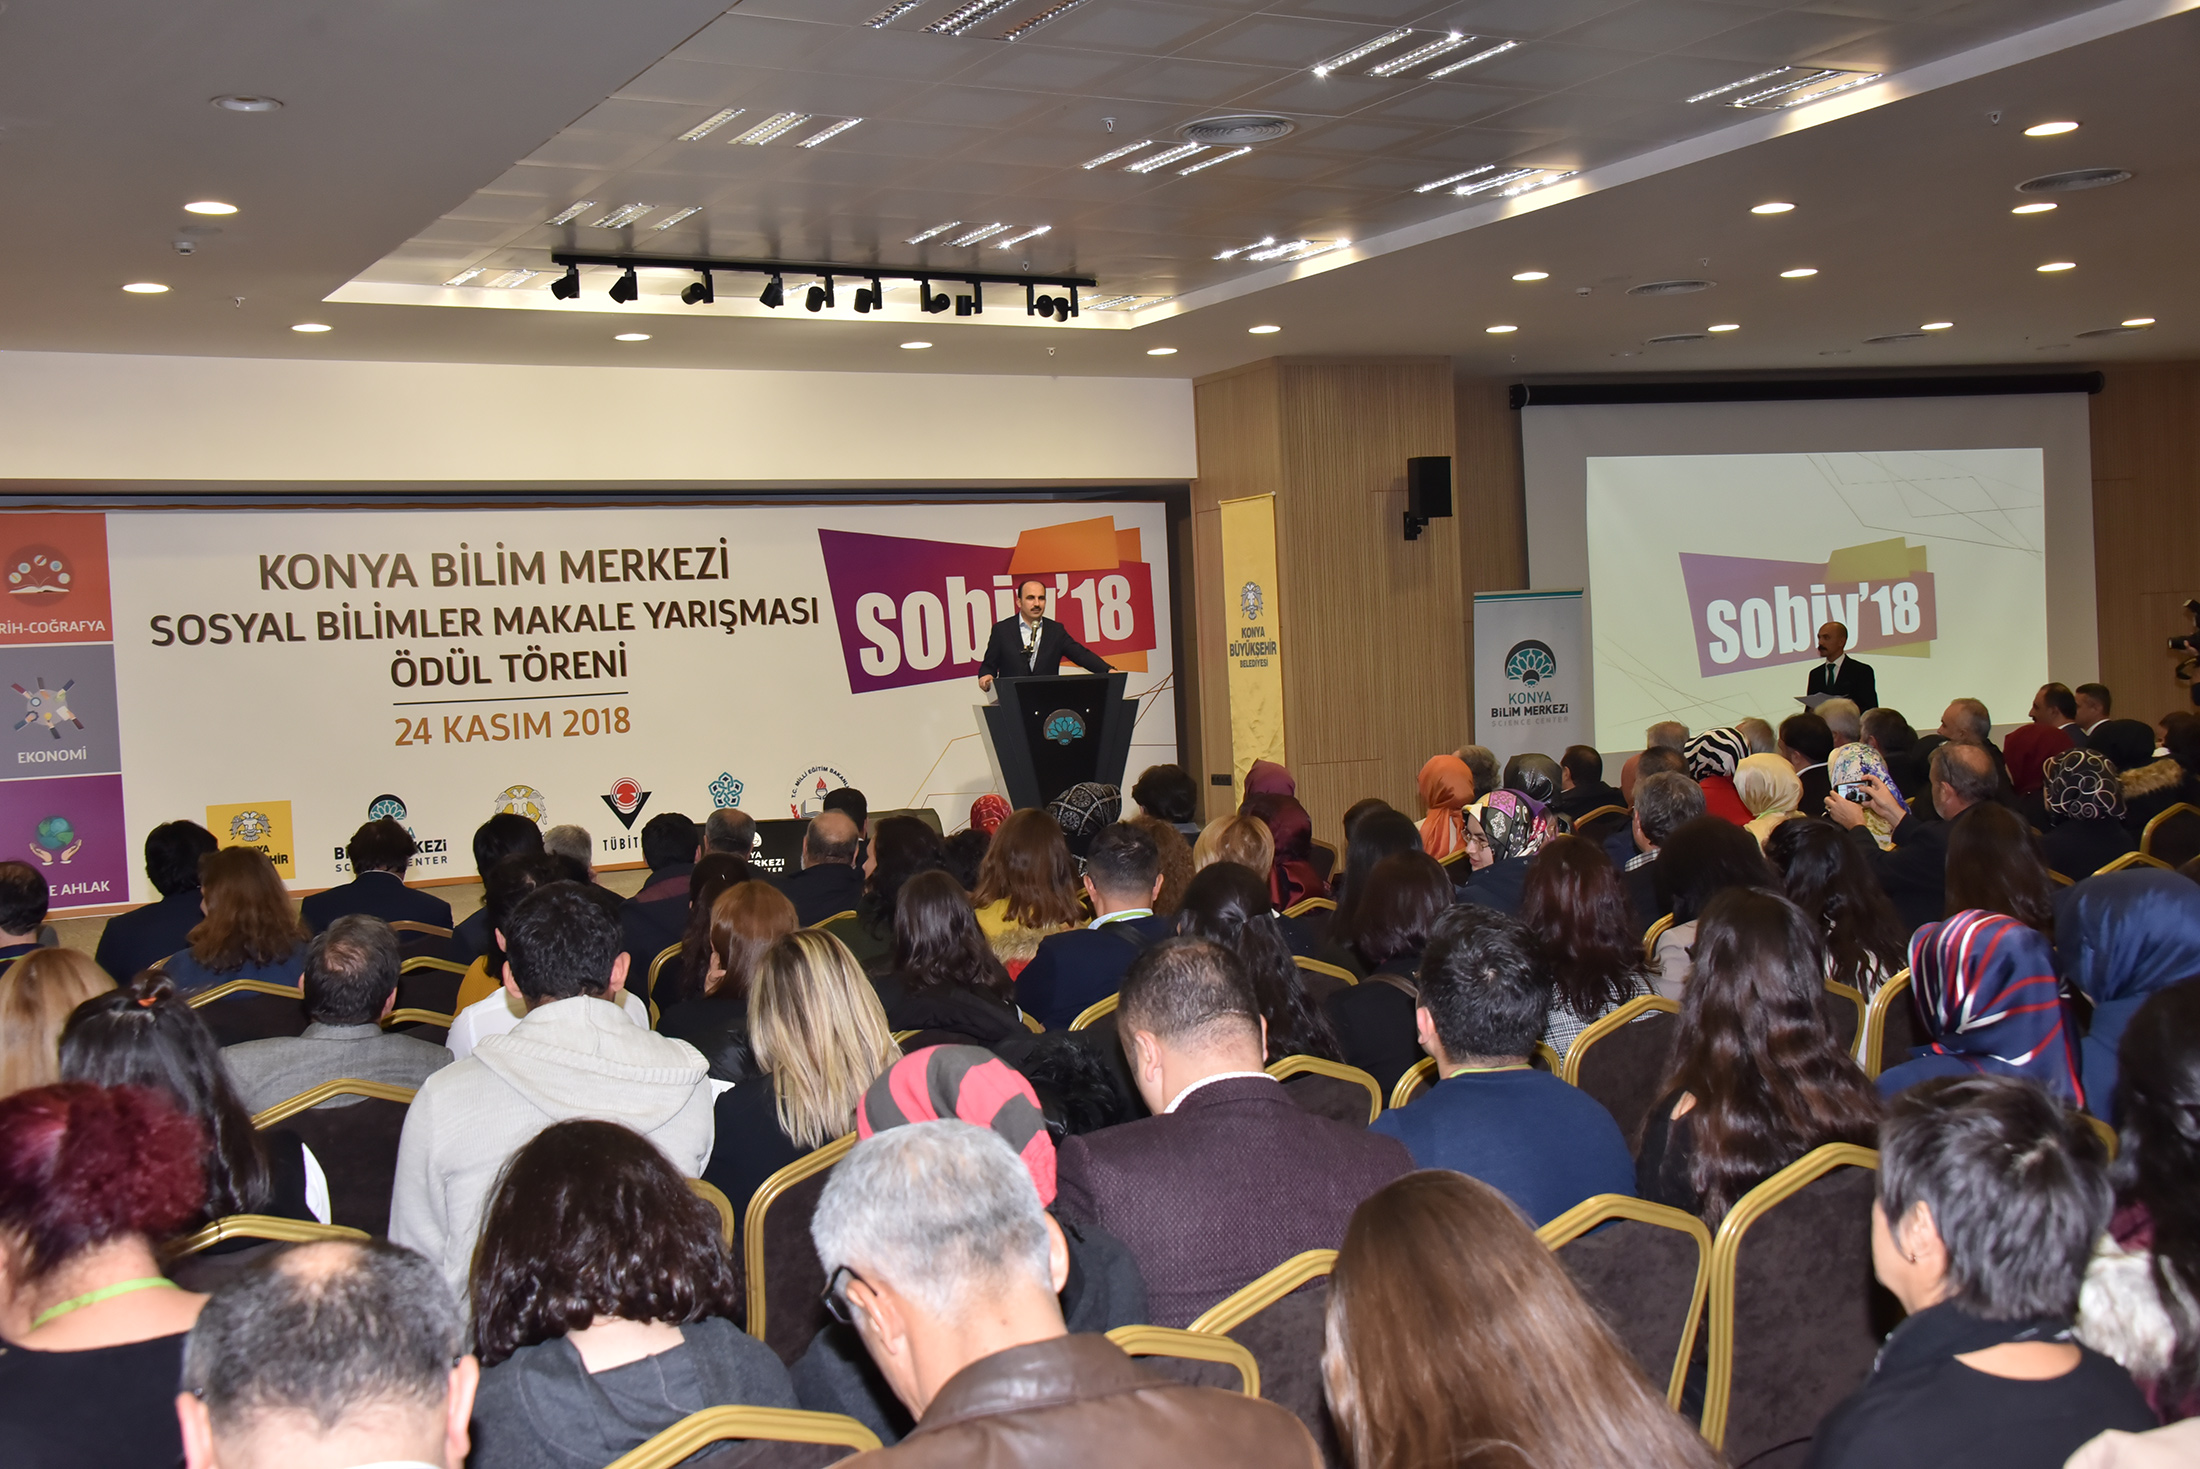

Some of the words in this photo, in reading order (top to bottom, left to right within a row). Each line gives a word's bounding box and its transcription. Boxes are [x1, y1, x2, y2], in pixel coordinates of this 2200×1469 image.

[259, 553, 419, 591] KONYA
[431, 541, 546, 588] BİLİM
[560, 536, 729, 584] MERKEZİ
[0, 618, 106, 635] RİH-COĞRAFYA
[150, 612, 306, 647] SOSYAL
[316, 601, 483, 641] BİLİMLER
[493, 602, 636, 636] MAKALE
[643, 597, 819, 635] YARIŞMASI
[1241, 626, 1265, 639] KONYA
[1229, 638, 1277, 658] BÜYÜKŞEHİR
[391, 647, 492, 688] ÖDÜL
[499, 641, 627, 683] TÖRENİ
[1508, 690, 1552, 705] KONYA
[394, 716, 433, 747] 24
[443, 710, 551, 744] KASIM
[562, 706, 631, 737] 2018
[1491, 718, 1532, 728] SCIENCE
[1535, 716, 1569, 725] CENTER
[17, 745, 87, 764] EKONOMİ
[807, 765, 829, 775] EĞİTİM
[603, 835, 639, 851] TÜBİT
[408, 856, 448, 867] ENTER
[49, 885, 58, 896] E
[61, 880, 110, 896] AHLAK
